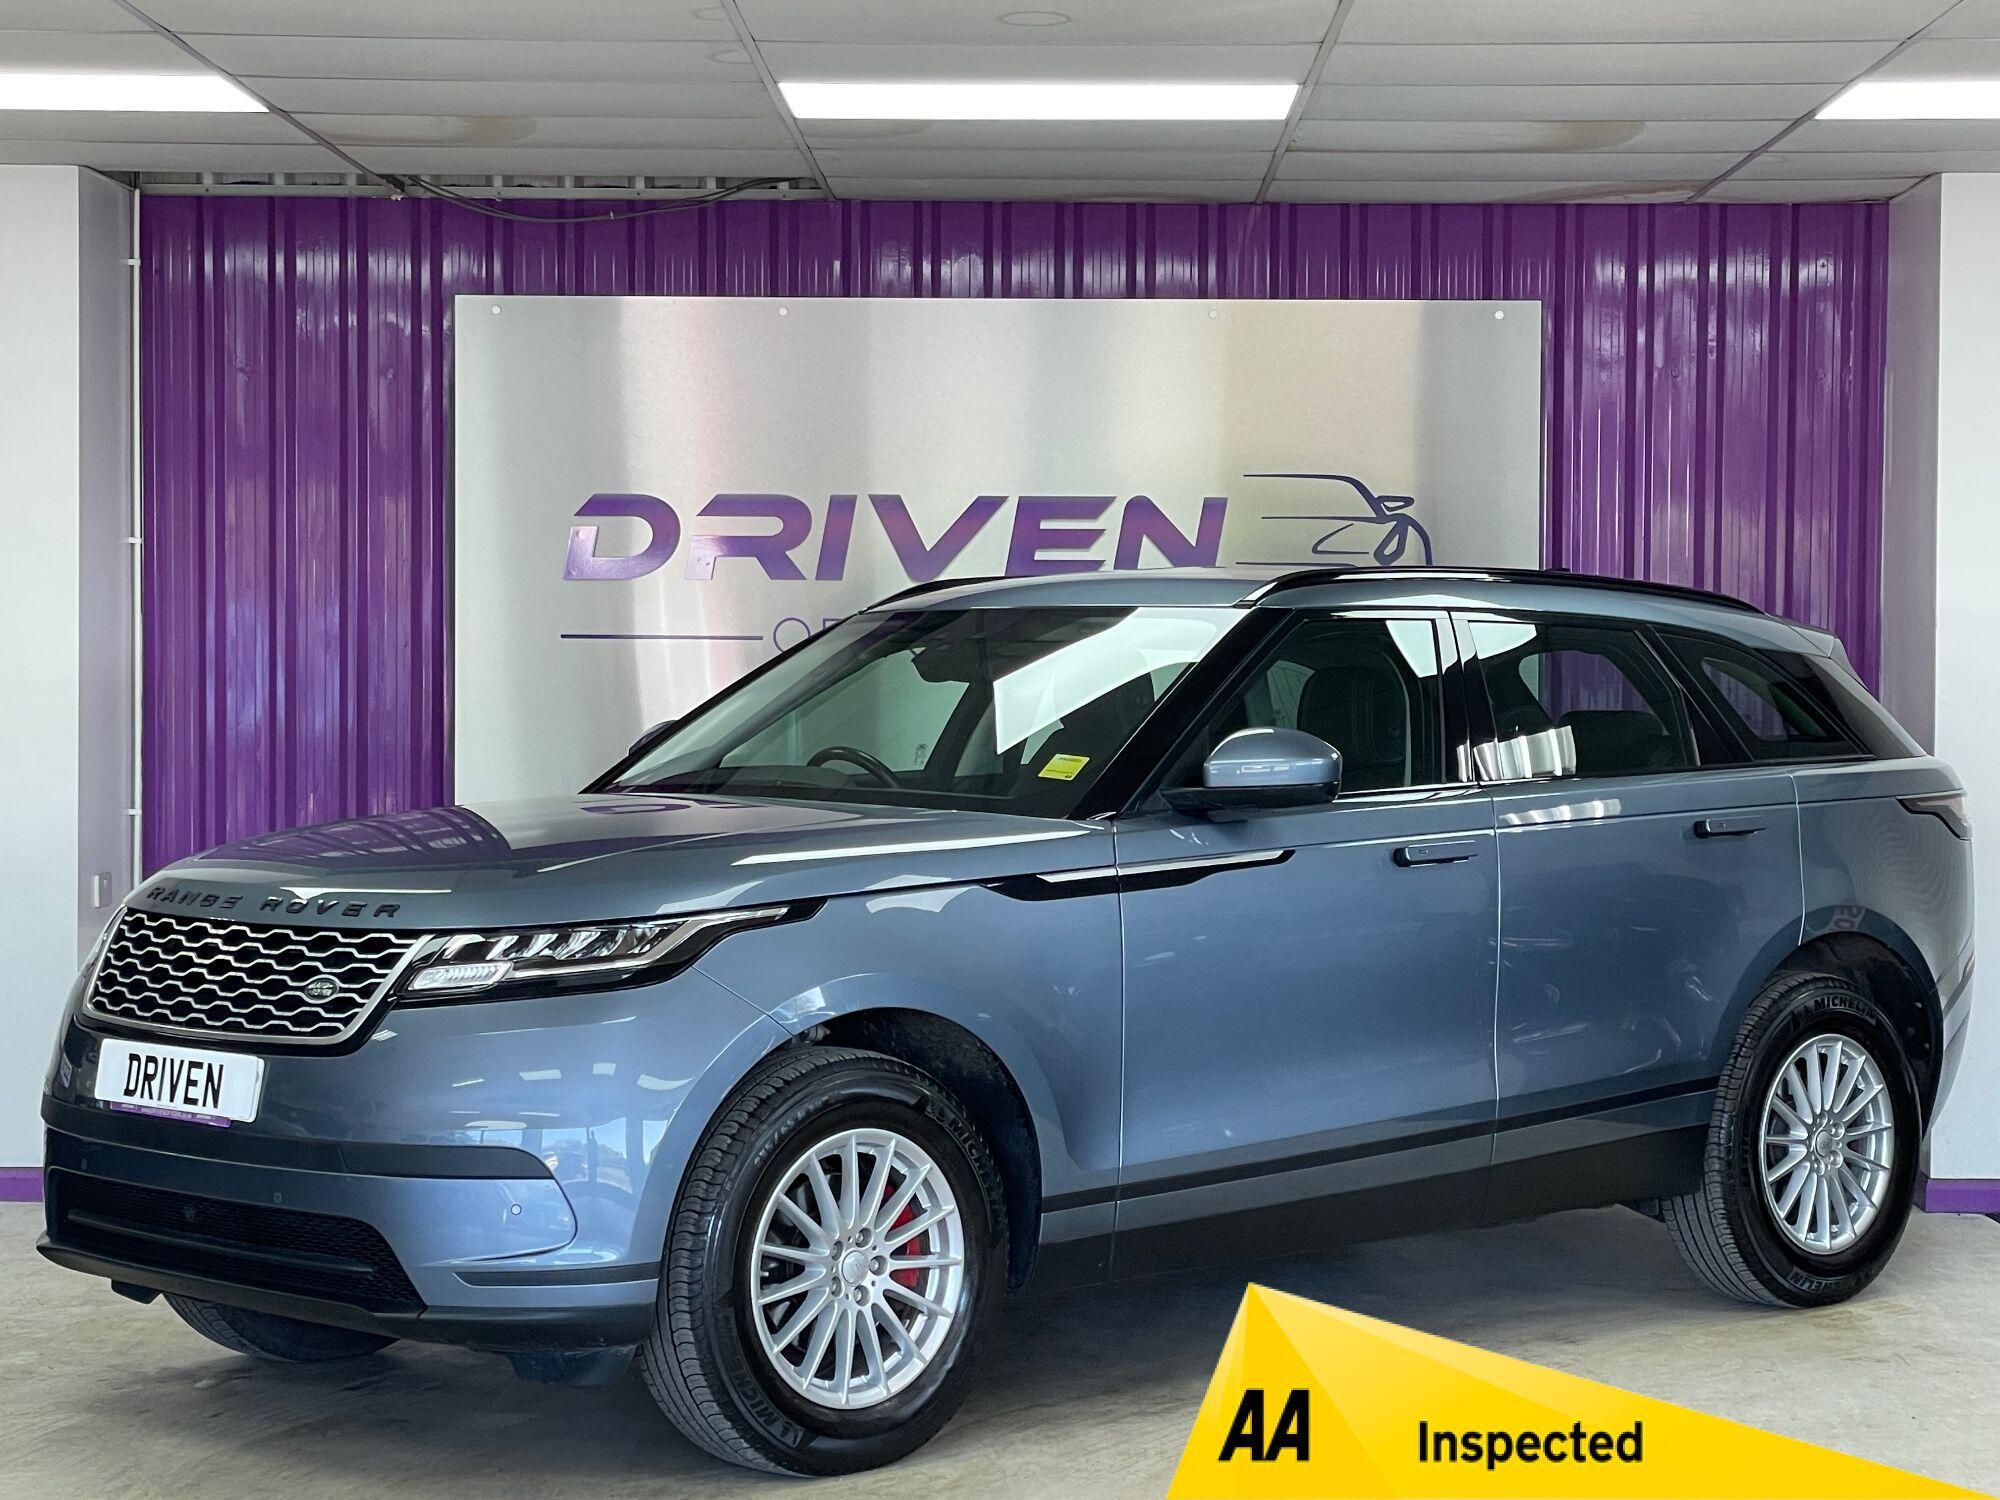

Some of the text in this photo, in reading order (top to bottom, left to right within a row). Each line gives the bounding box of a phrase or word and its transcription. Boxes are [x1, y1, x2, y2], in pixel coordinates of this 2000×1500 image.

[563, 493, 1229, 582] DRIVEN
[147, 887, 401, 918] RANGE ROVER
[123, 1053, 224, 1109] DRIVEN
